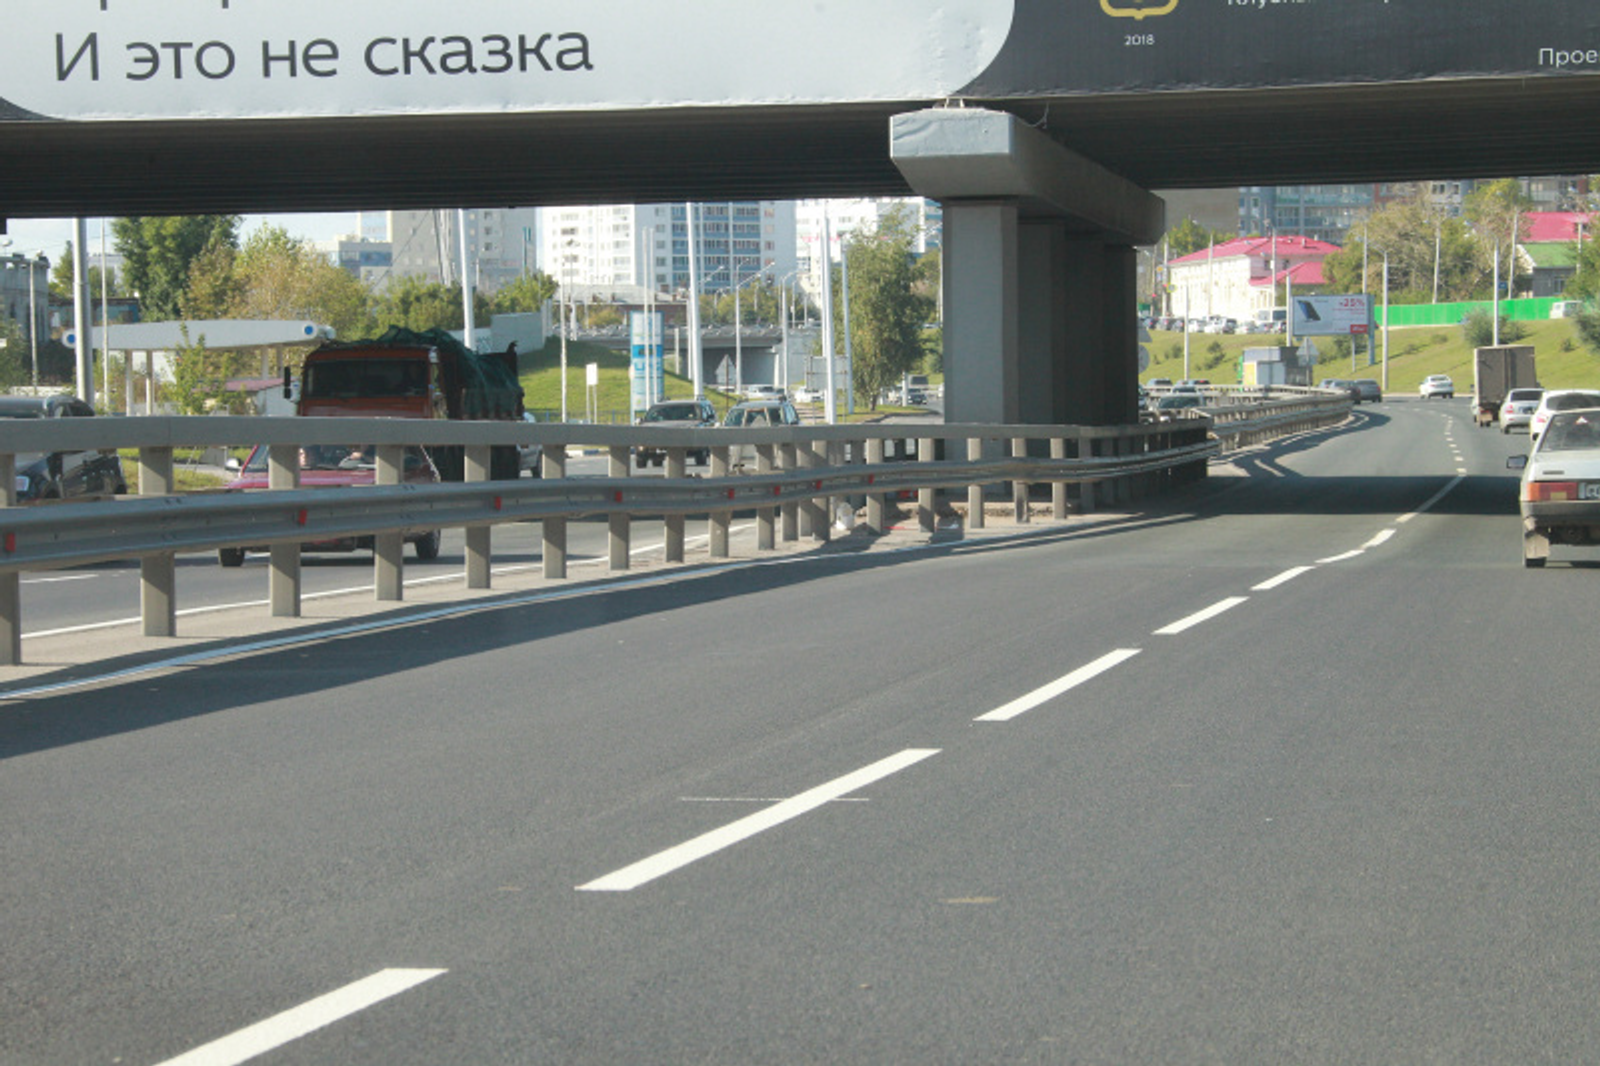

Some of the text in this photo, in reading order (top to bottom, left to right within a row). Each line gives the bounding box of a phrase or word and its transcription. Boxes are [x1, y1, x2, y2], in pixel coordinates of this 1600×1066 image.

[1124, 33, 1156, 47] 2018
[55, 32, 594, 82] И это не сказка
